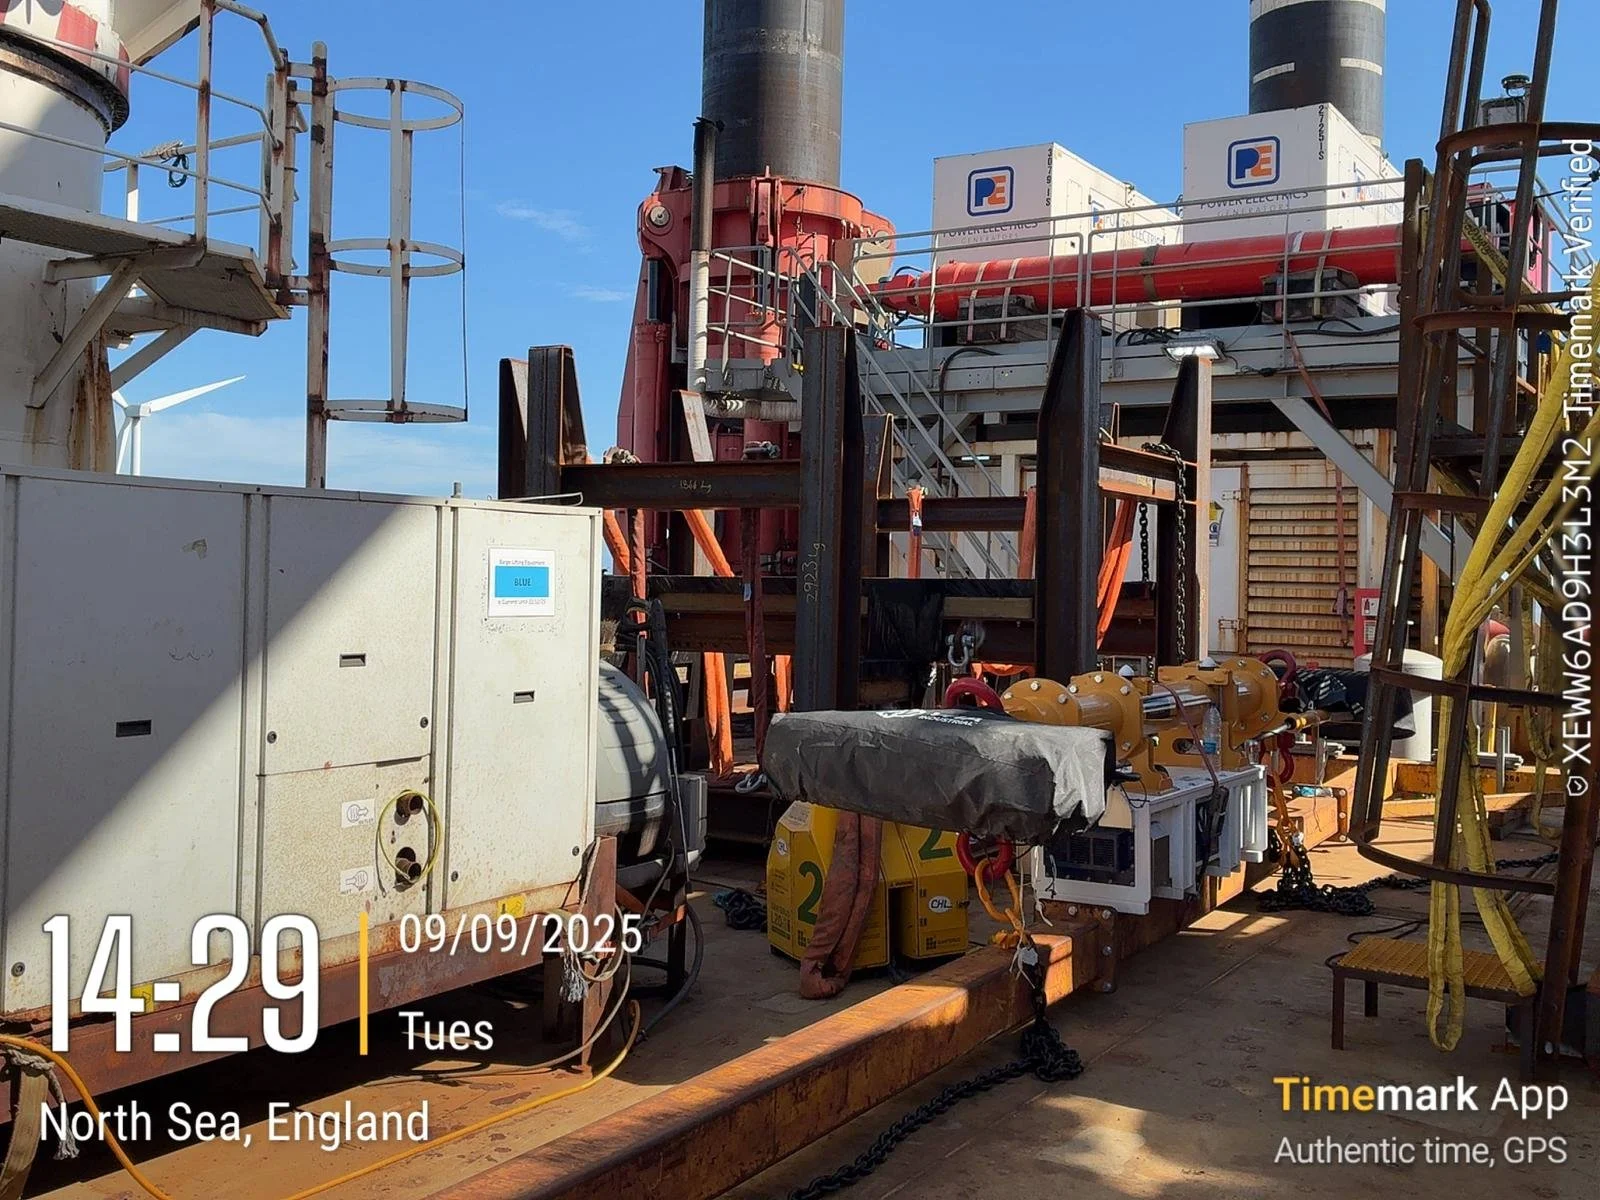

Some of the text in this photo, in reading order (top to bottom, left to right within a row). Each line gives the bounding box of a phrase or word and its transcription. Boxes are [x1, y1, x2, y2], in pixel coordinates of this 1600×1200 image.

[514, 577, 532, 587] BLUE
[798, 860, 824, 926] 2
[930, 898, 953, 909] CHL
